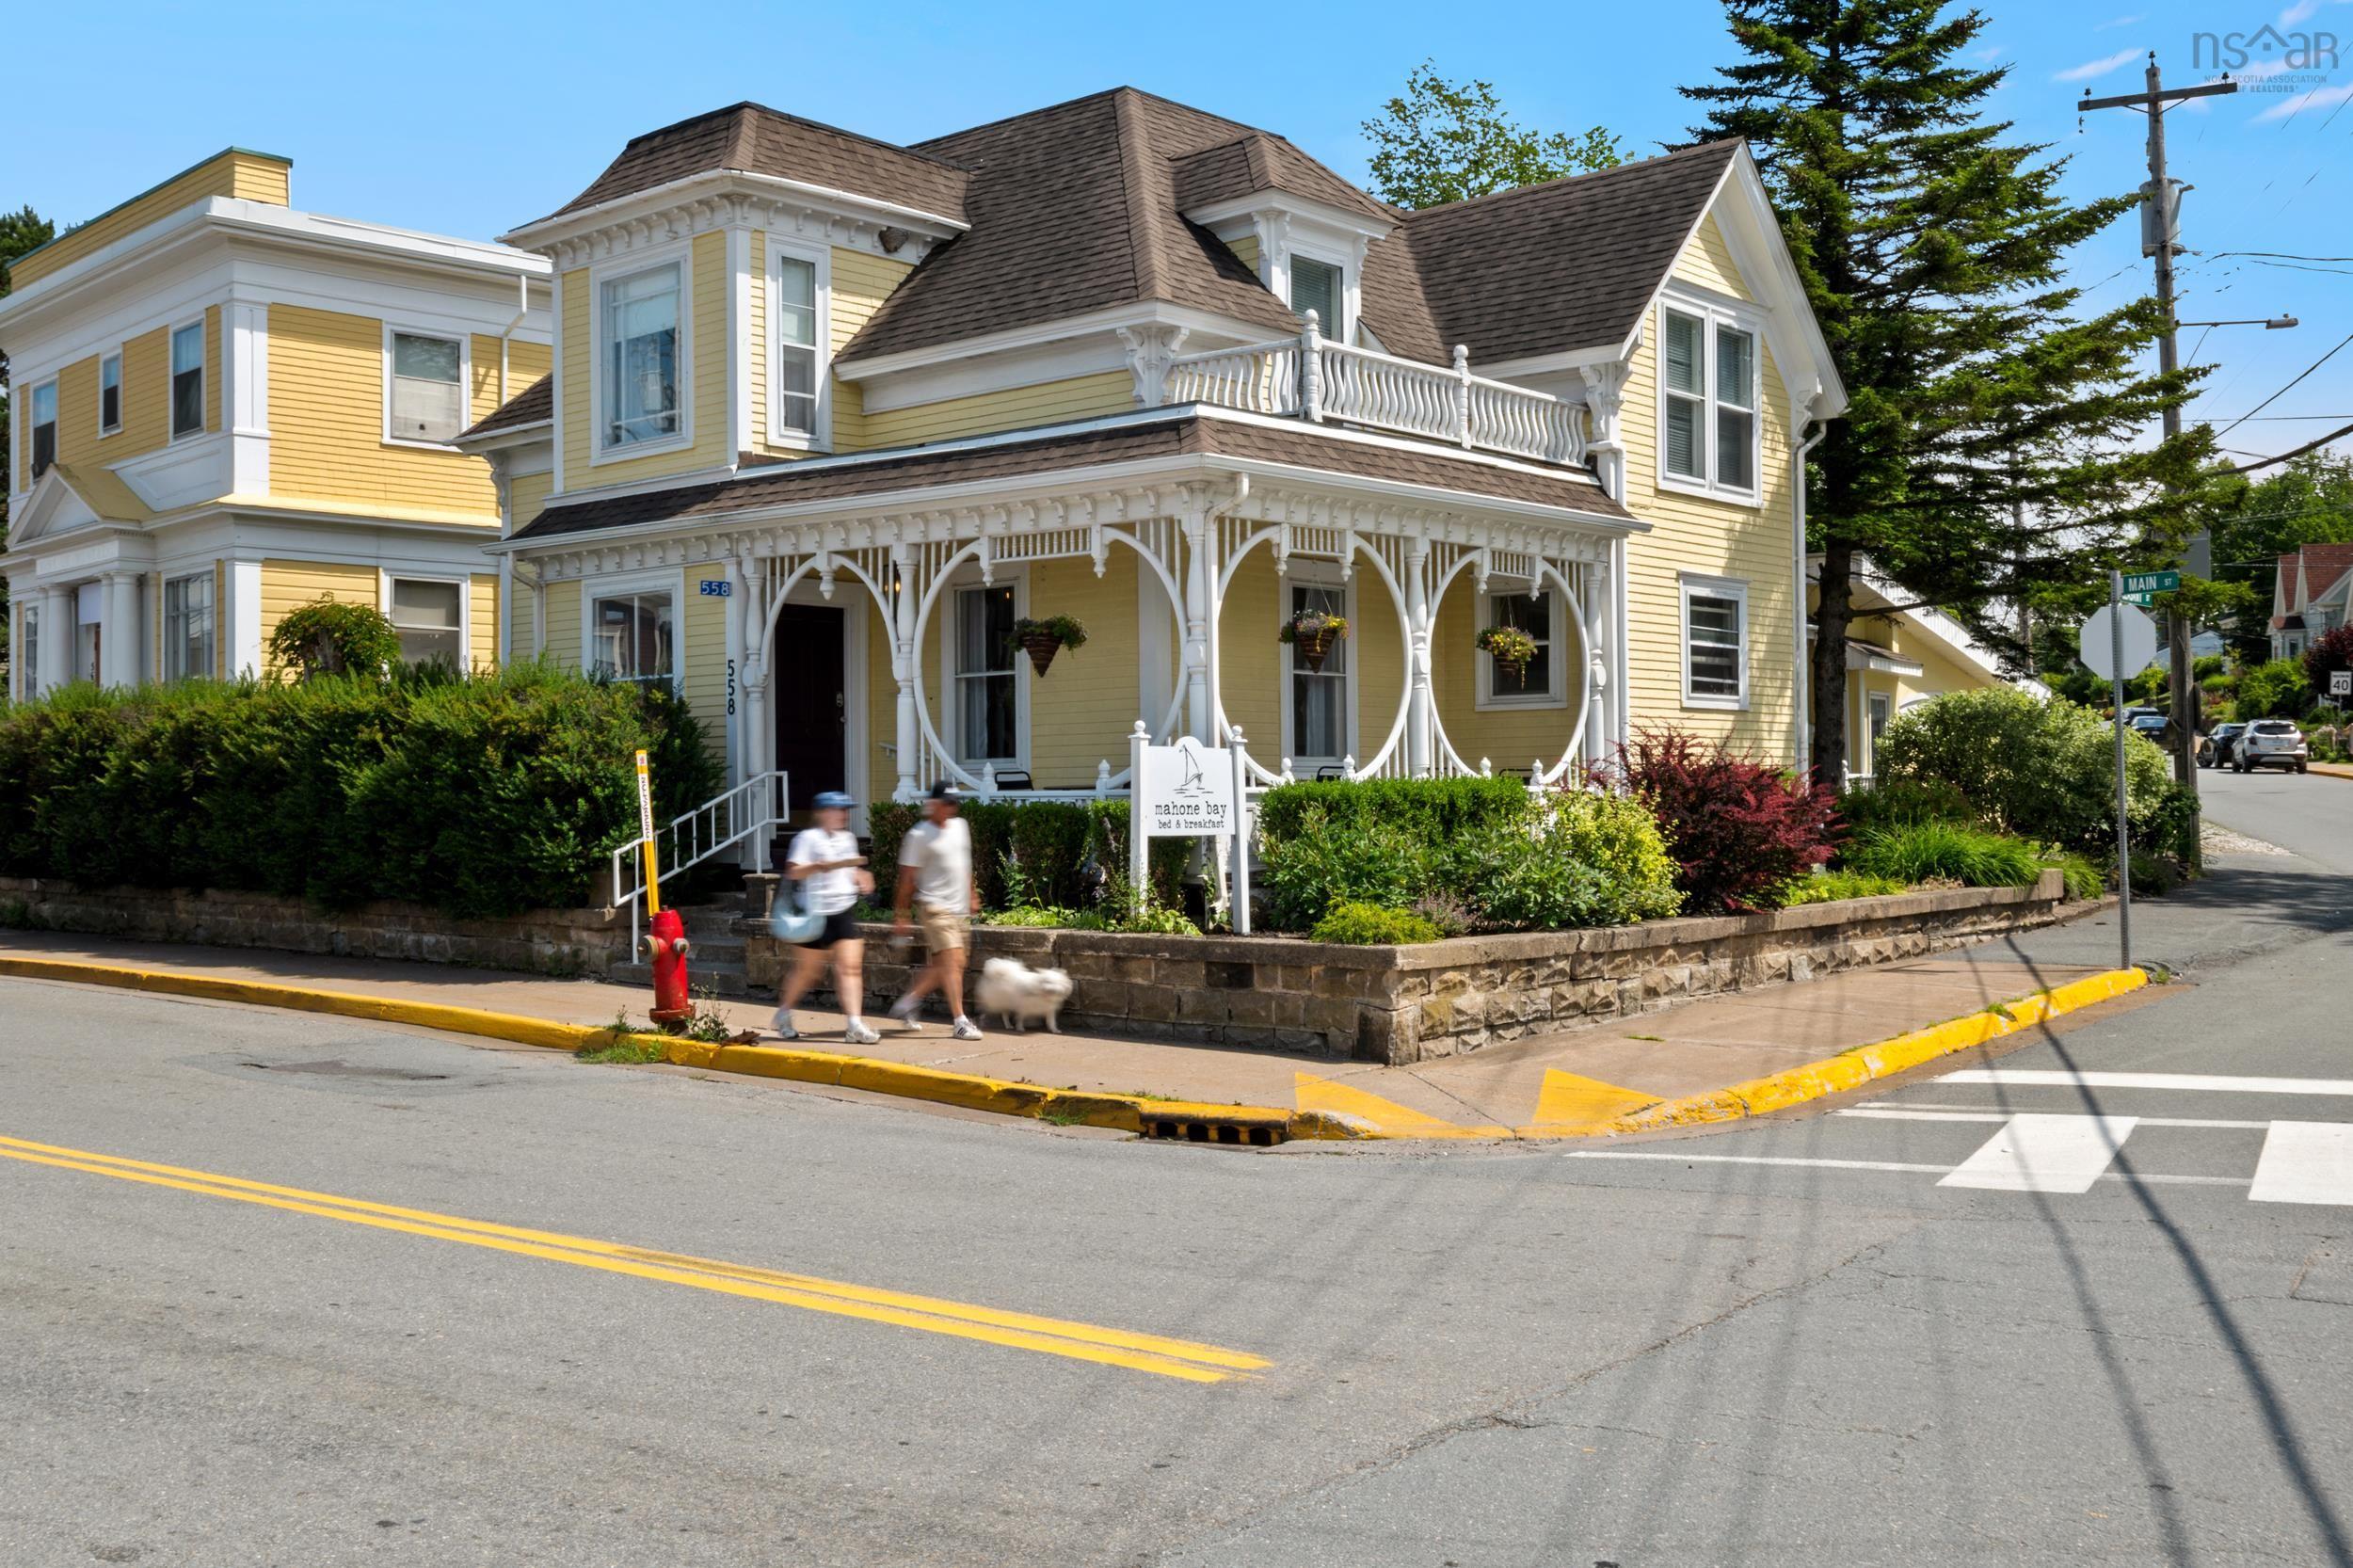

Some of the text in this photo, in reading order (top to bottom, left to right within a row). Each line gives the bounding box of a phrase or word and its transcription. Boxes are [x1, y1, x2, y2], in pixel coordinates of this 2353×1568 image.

[701, 582, 730, 596] 558
[2128, 576, 2156, 591] MAIN
[728, 659, 736, 715] 558
[2333, 680, 2349, 691] 40
[1155, 801, 1226, 818] mahone bay
[1158, 819, 1225, 829] bed & breakfast
